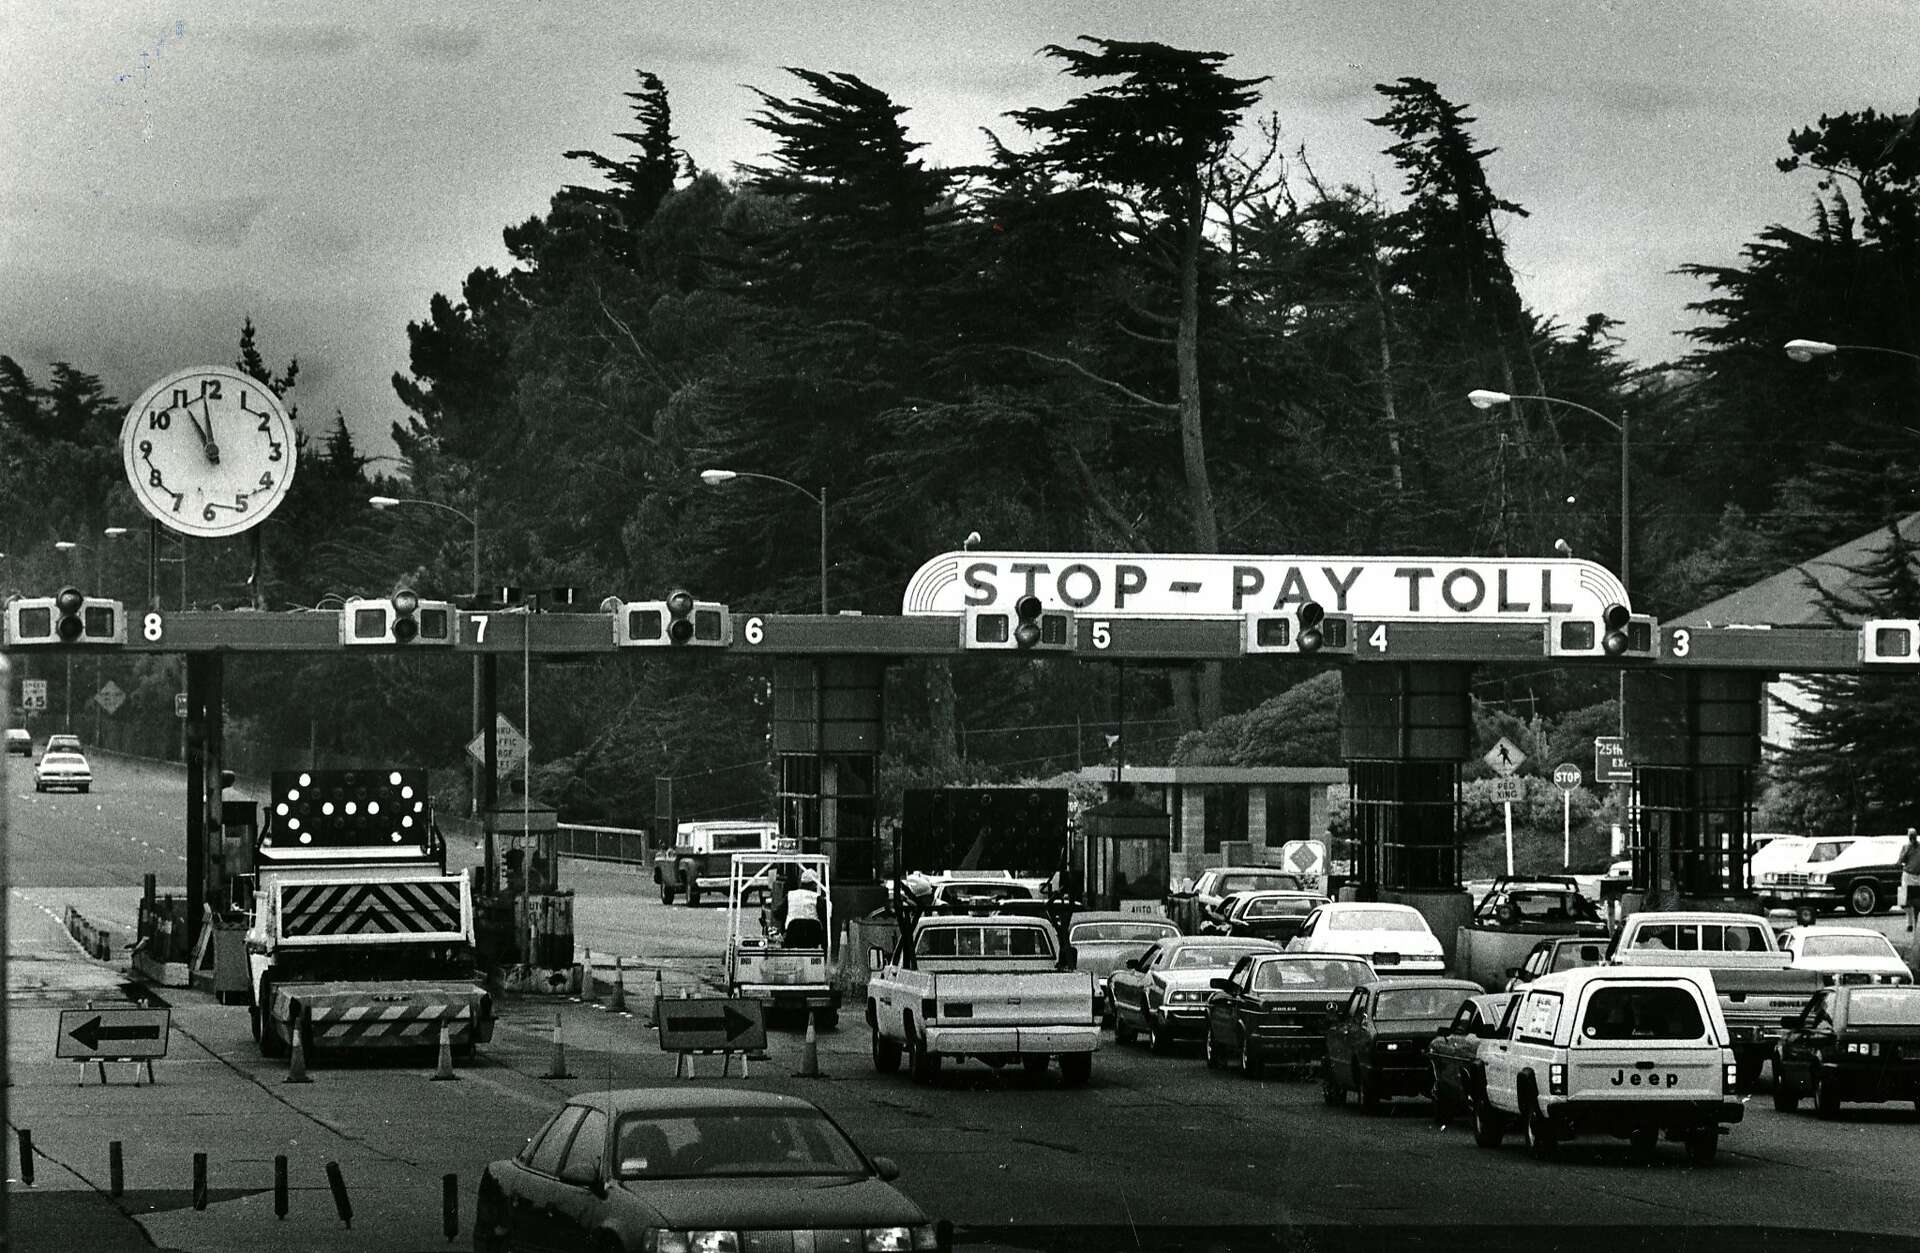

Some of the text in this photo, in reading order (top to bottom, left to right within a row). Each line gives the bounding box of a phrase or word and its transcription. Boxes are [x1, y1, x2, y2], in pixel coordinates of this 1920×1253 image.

[201, 380, 222, 399] 12
[173, 390, 188, 408] 11
[240, 391, 247, 409] 1
[150, 411, 171, 430] 10
[258, 412, 270, 431] 2
[139, 440, 152, 459] 9
[269, 443, 282, 461] 3
[150, 469, 162, 487] 8
[259, 471, 274, 489] 4
[172, 493, 184, 512] 7
[235, 494, 248, 512] 5
[203, 503, 216, 521] 6
[964, 563, 1148, 609] STOP
[1232, 566, 1364, 611] PAY
[1394, 567, 1573, 612] TOLL
[144, 613, 162, 641] 8
[471, 615, 488, 643] 7
[745, 617, 763, 644] 6
[1092, 621, 1111, 649] 5
[1369, 624, 1388, 651] 4
[1672, 629, 1690, 656] 3
[24, 696, 45, 707] 45
[1599, 743, 1623, 755] 25th
[1497, 782, 1516, 790] PED
[1555, 771, 1581, 783] STOP
[1496, 790, 1518, 799] XING
[1131, 905, 1151, 913] AUTO
[1611, 1069, 1679, 1088] Jeep
